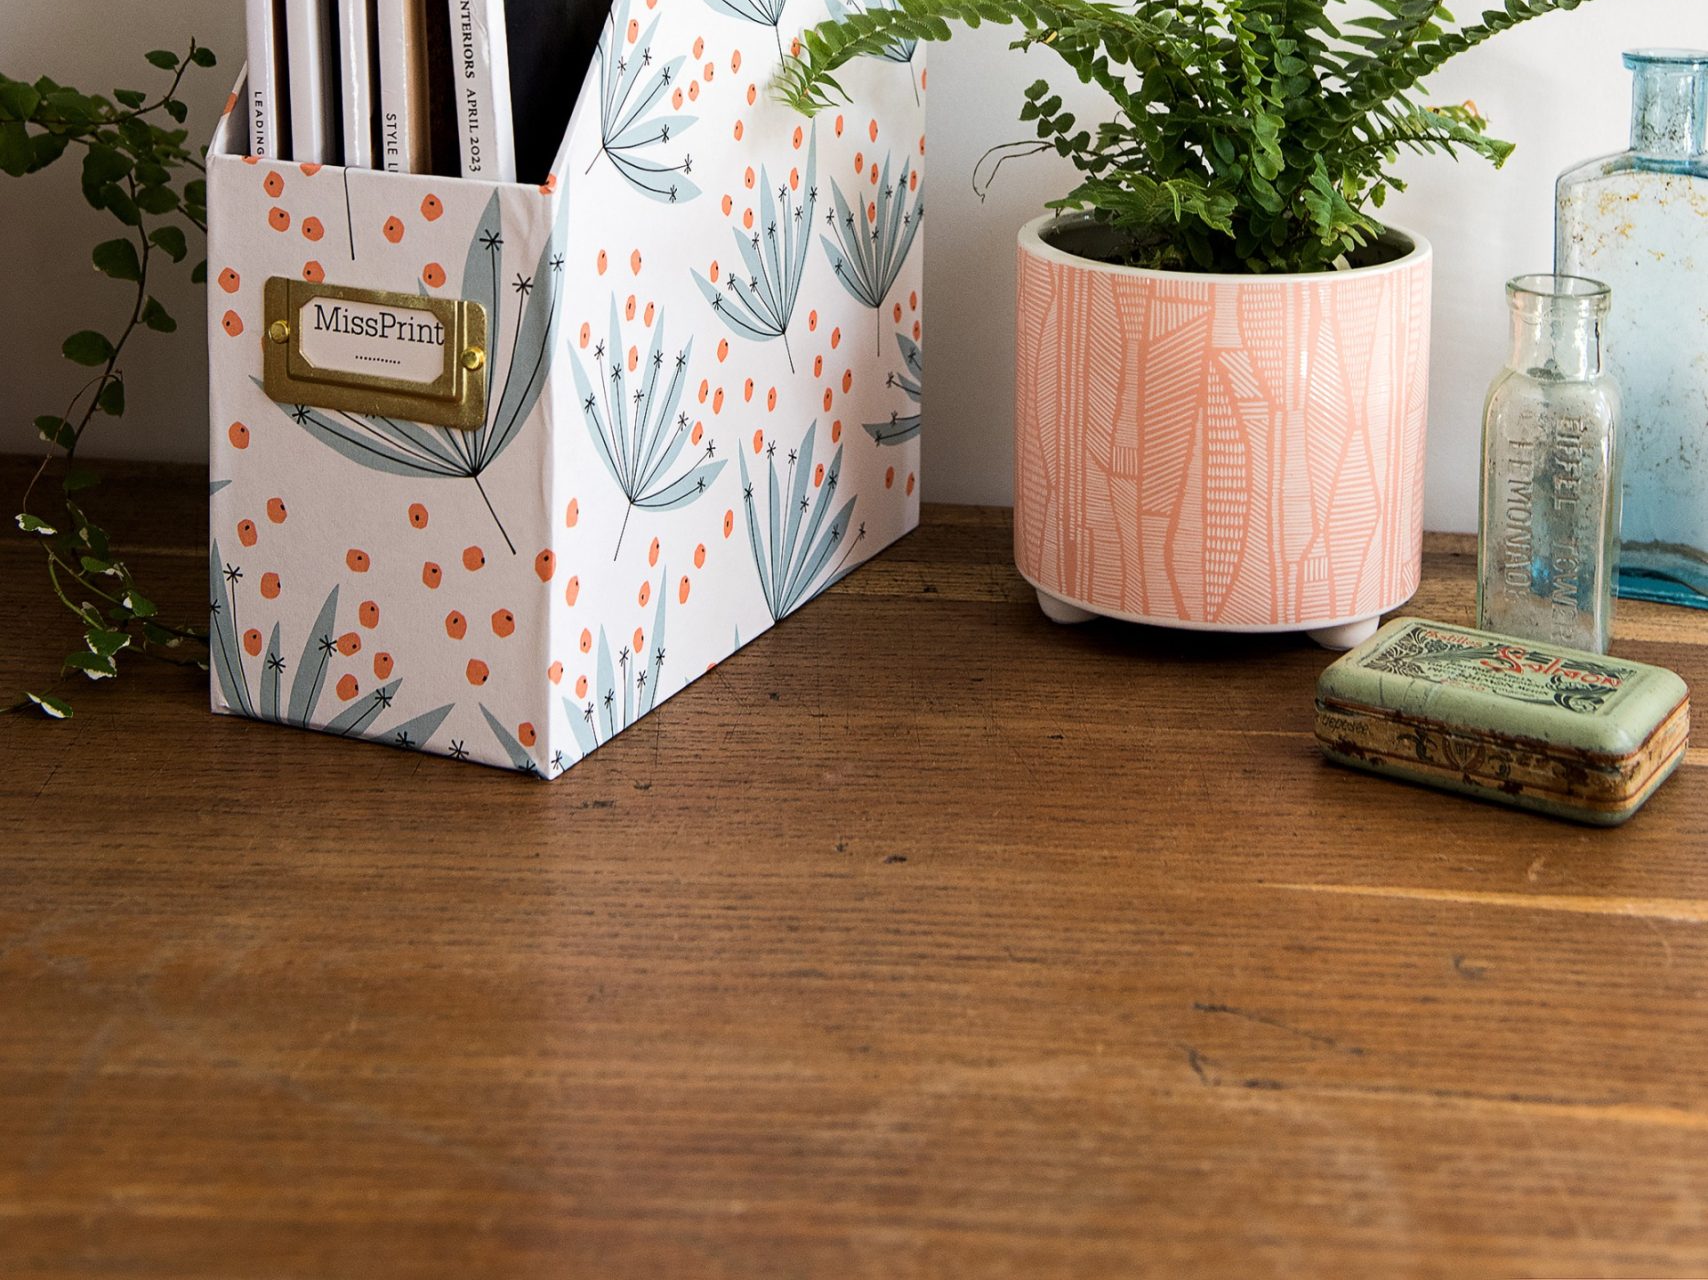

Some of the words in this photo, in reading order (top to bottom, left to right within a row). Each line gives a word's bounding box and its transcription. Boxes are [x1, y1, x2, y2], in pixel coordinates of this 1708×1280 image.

[254, 91, 265, 156] LEADING
[466, 88, 481, 133] APRIL
[385, 112, 399, 156] STYLE
[469, 136, 482, 173] 2023
[313, 304, 445, 346] MissPrint
